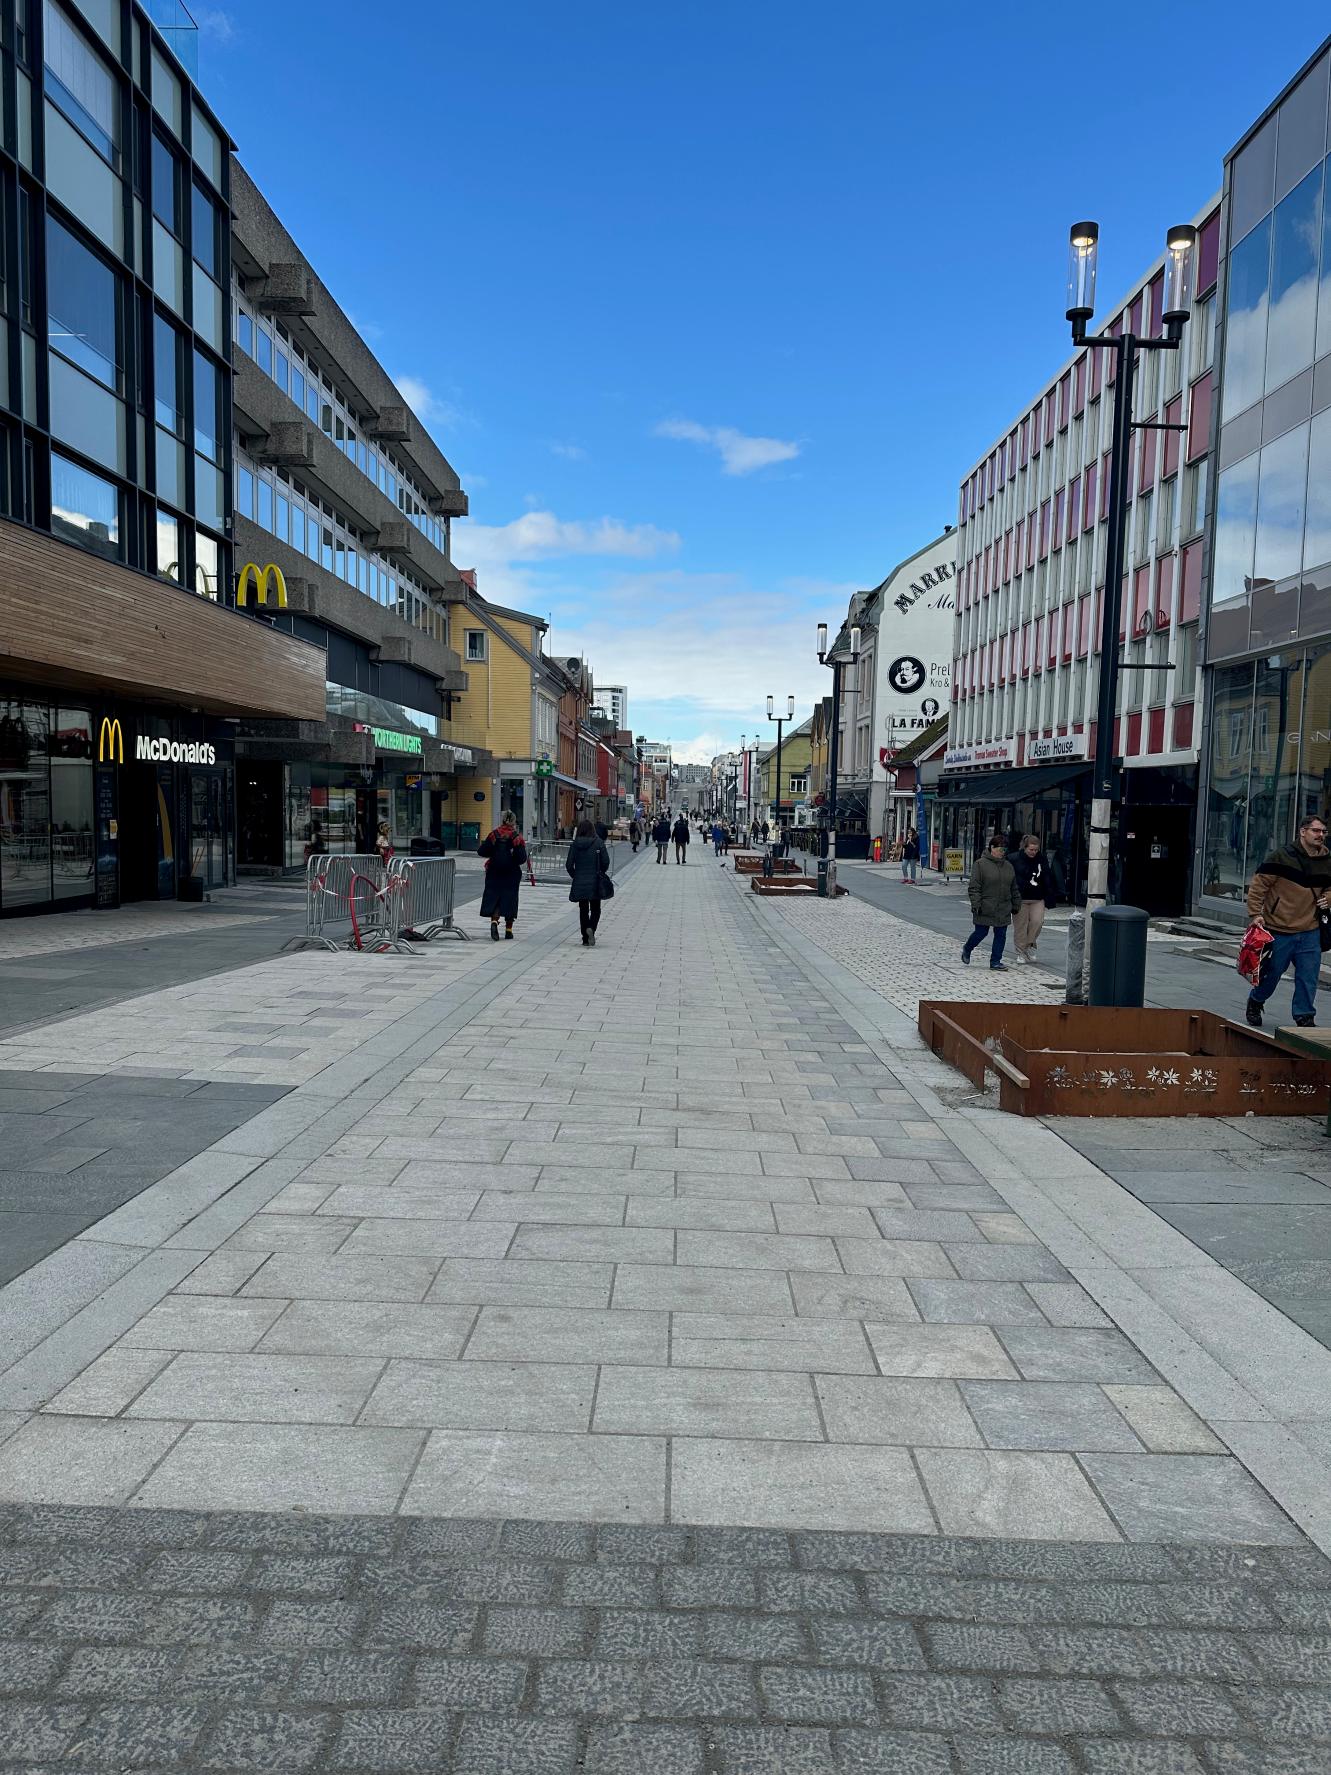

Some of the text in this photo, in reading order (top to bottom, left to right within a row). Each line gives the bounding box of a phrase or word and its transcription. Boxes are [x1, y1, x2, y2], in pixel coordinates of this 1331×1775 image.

[136, 735, 216, 766] McDonald's
[1033, 739, 1074, 757] Asian House
